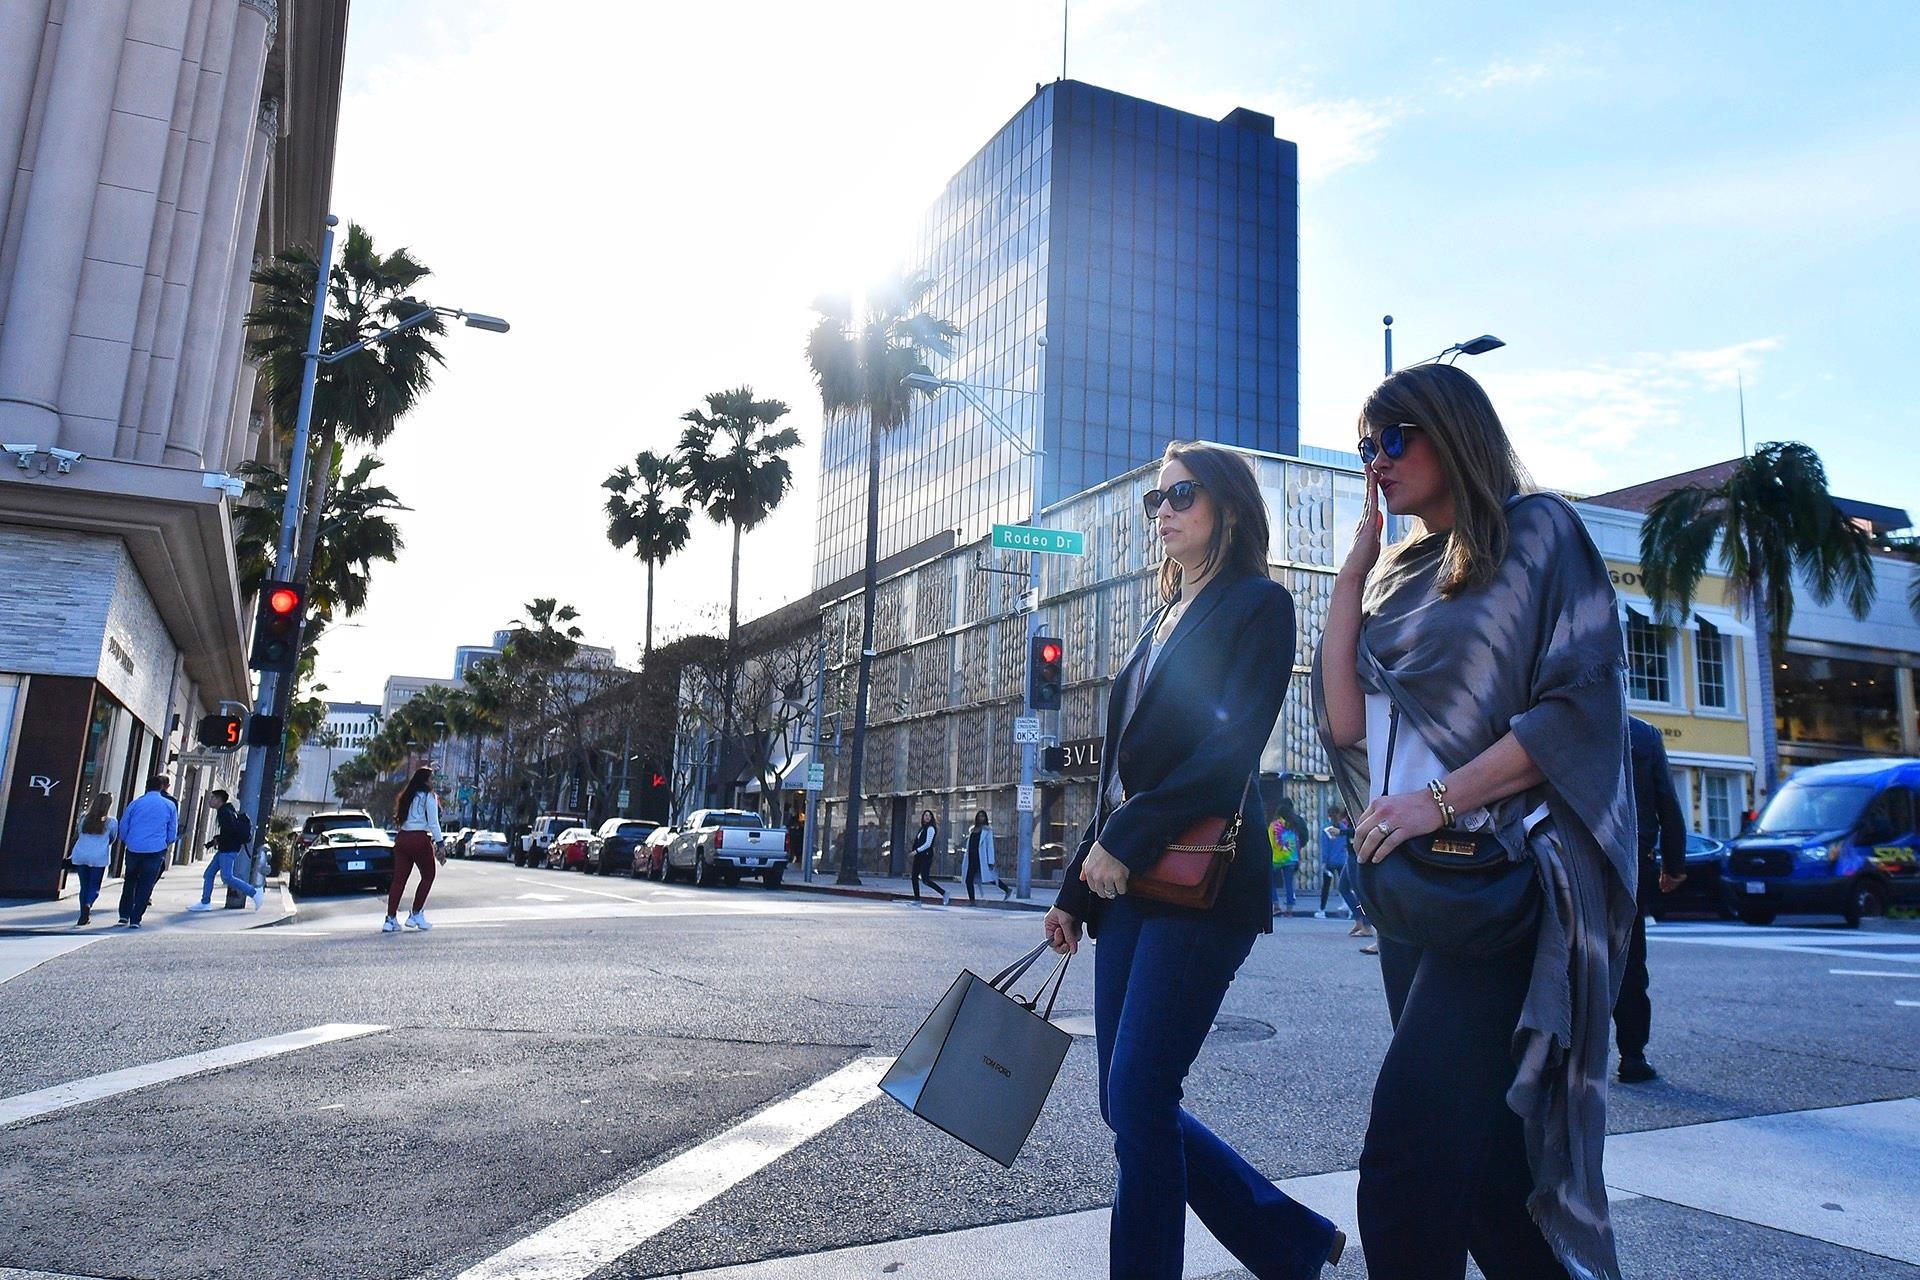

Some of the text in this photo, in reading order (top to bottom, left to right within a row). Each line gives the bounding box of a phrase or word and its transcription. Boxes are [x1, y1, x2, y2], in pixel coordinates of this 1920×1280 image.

[1004, 531, 1072, 548] Rodeo Dr
[227, 722, 237, 742] 5
[1016, 731, 1027, 741] OK
[984, 1055, 1012, 1077] TOM FORD
